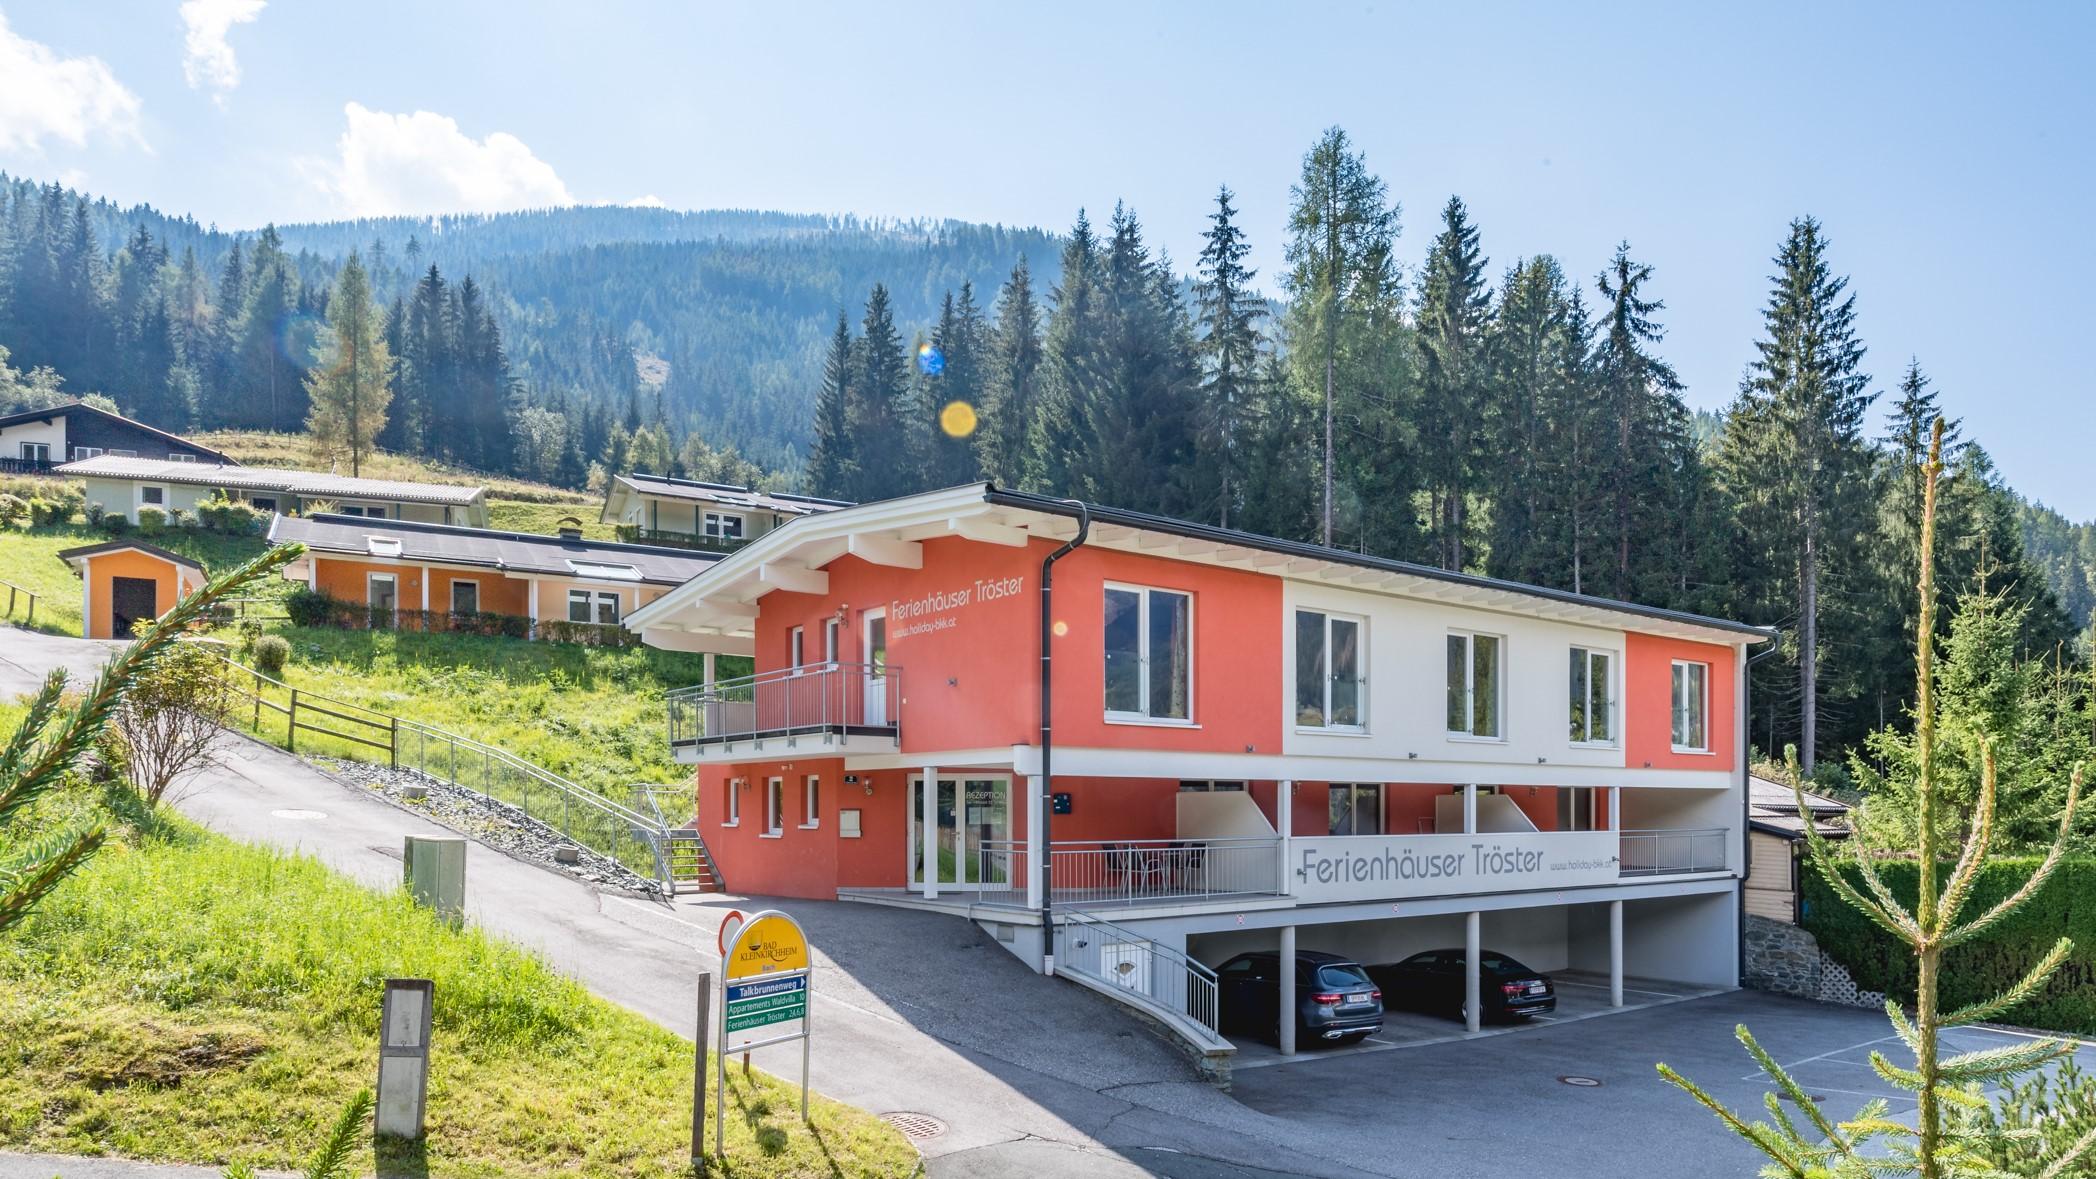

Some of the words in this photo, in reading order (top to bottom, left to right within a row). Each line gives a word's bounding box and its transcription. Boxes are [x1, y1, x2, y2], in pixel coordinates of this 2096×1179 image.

[892, 588, 971, 621] Ferienhäuser
[975, 576, 1024, 603] Tröster
[892, 616, 957, 640] www.holiday-bkk.at
[966, 791, 1006, 800] REZEPTION
[1302, 846, 1465, 885] Ferienhäuser
[1471, 843, 1544, 876] Tröster
[763, 941, 777, 950] BAD
[740, 946, 797, 962] KLEINKIRCHHEIM
[739, 981, 797, 998] Talkbrunnenweg
[728, 1001, 771, 1016] Appartements
